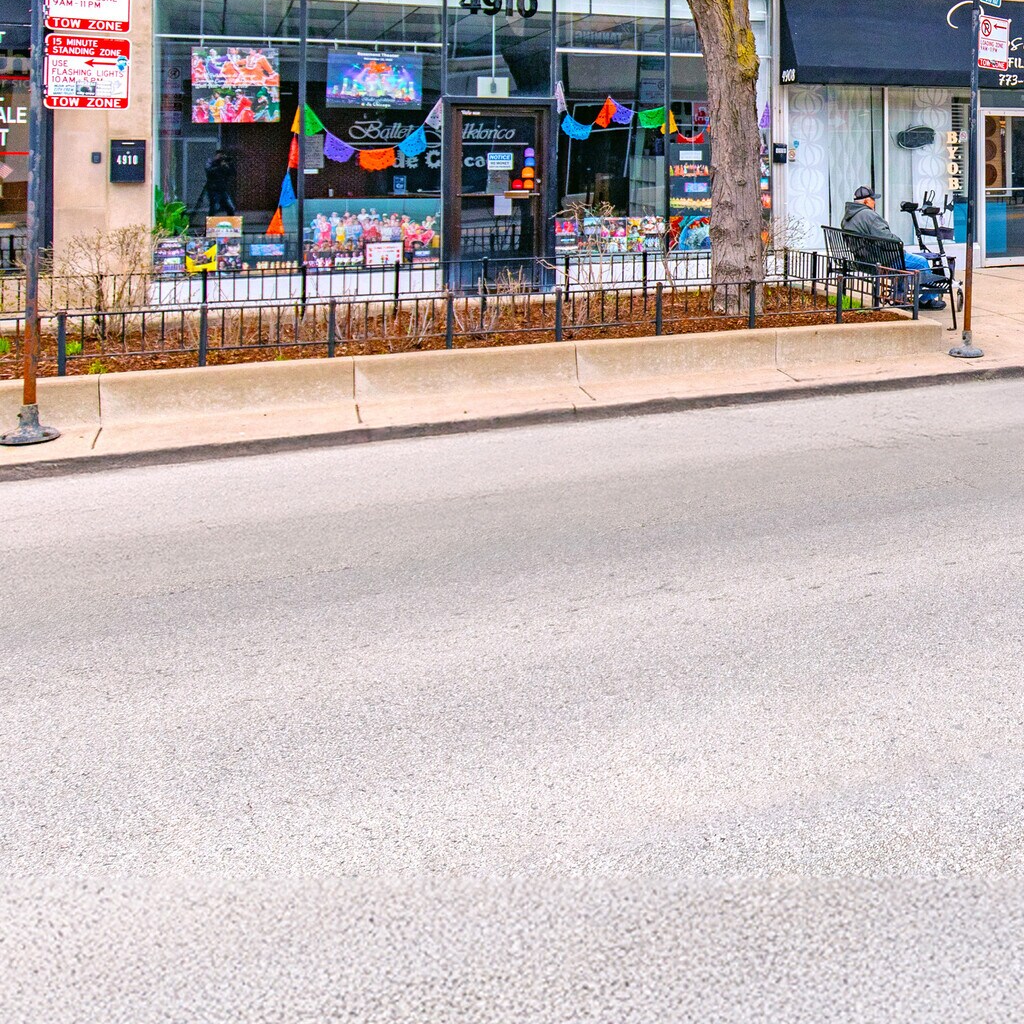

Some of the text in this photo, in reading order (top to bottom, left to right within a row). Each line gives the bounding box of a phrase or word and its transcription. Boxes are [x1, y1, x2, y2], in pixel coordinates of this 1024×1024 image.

[52, 17, 123, 32] TOW ZONE
[52, 37, 99, 48] 15 MINUTE
[52, 46, 122, 57] STANDING ZONE
[51, 60, 69, 68] USE
[51, 67, 125, 78] FLASHING LIGHTS
[51, 97, 122, 109] TOW ZONE
[0, 107, 28, 124] ALE
[348, 120, 415, 142] Ballet
[116, 154, 139, 166] 4910
